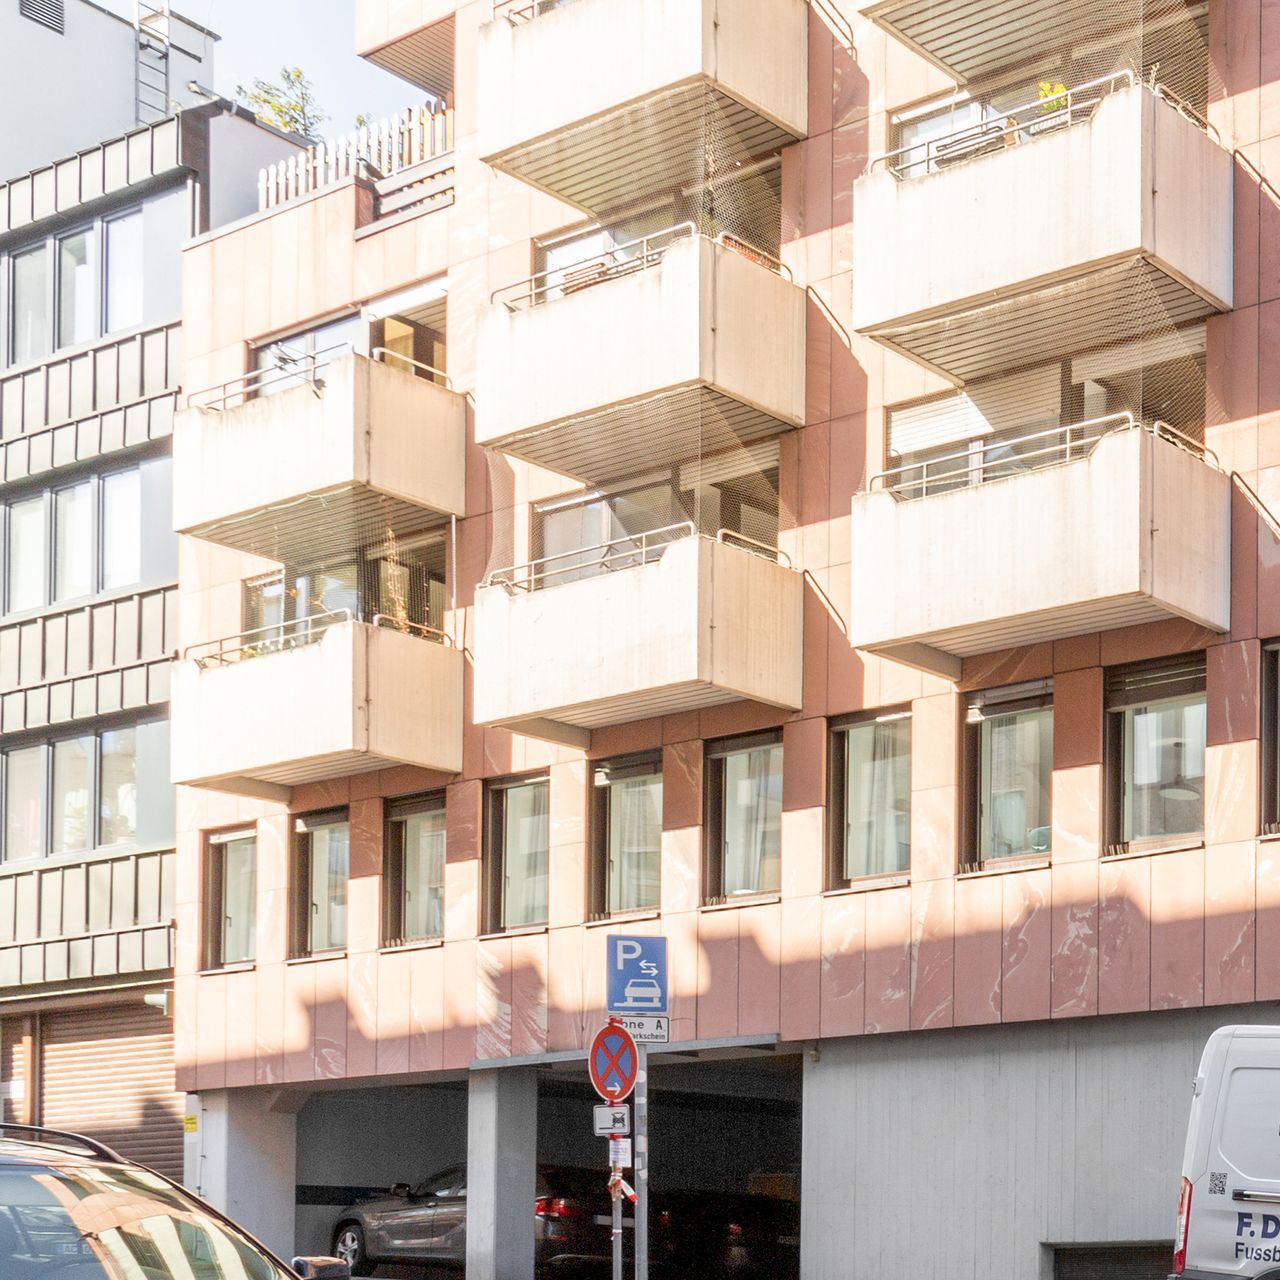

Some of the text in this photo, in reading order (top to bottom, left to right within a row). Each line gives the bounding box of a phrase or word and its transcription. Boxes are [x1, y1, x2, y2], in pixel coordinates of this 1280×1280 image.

[616, 939, 642, 971] P
[622, 1020, 662, 1030] one A
[631, 1031, 666, 1040] arkschein
